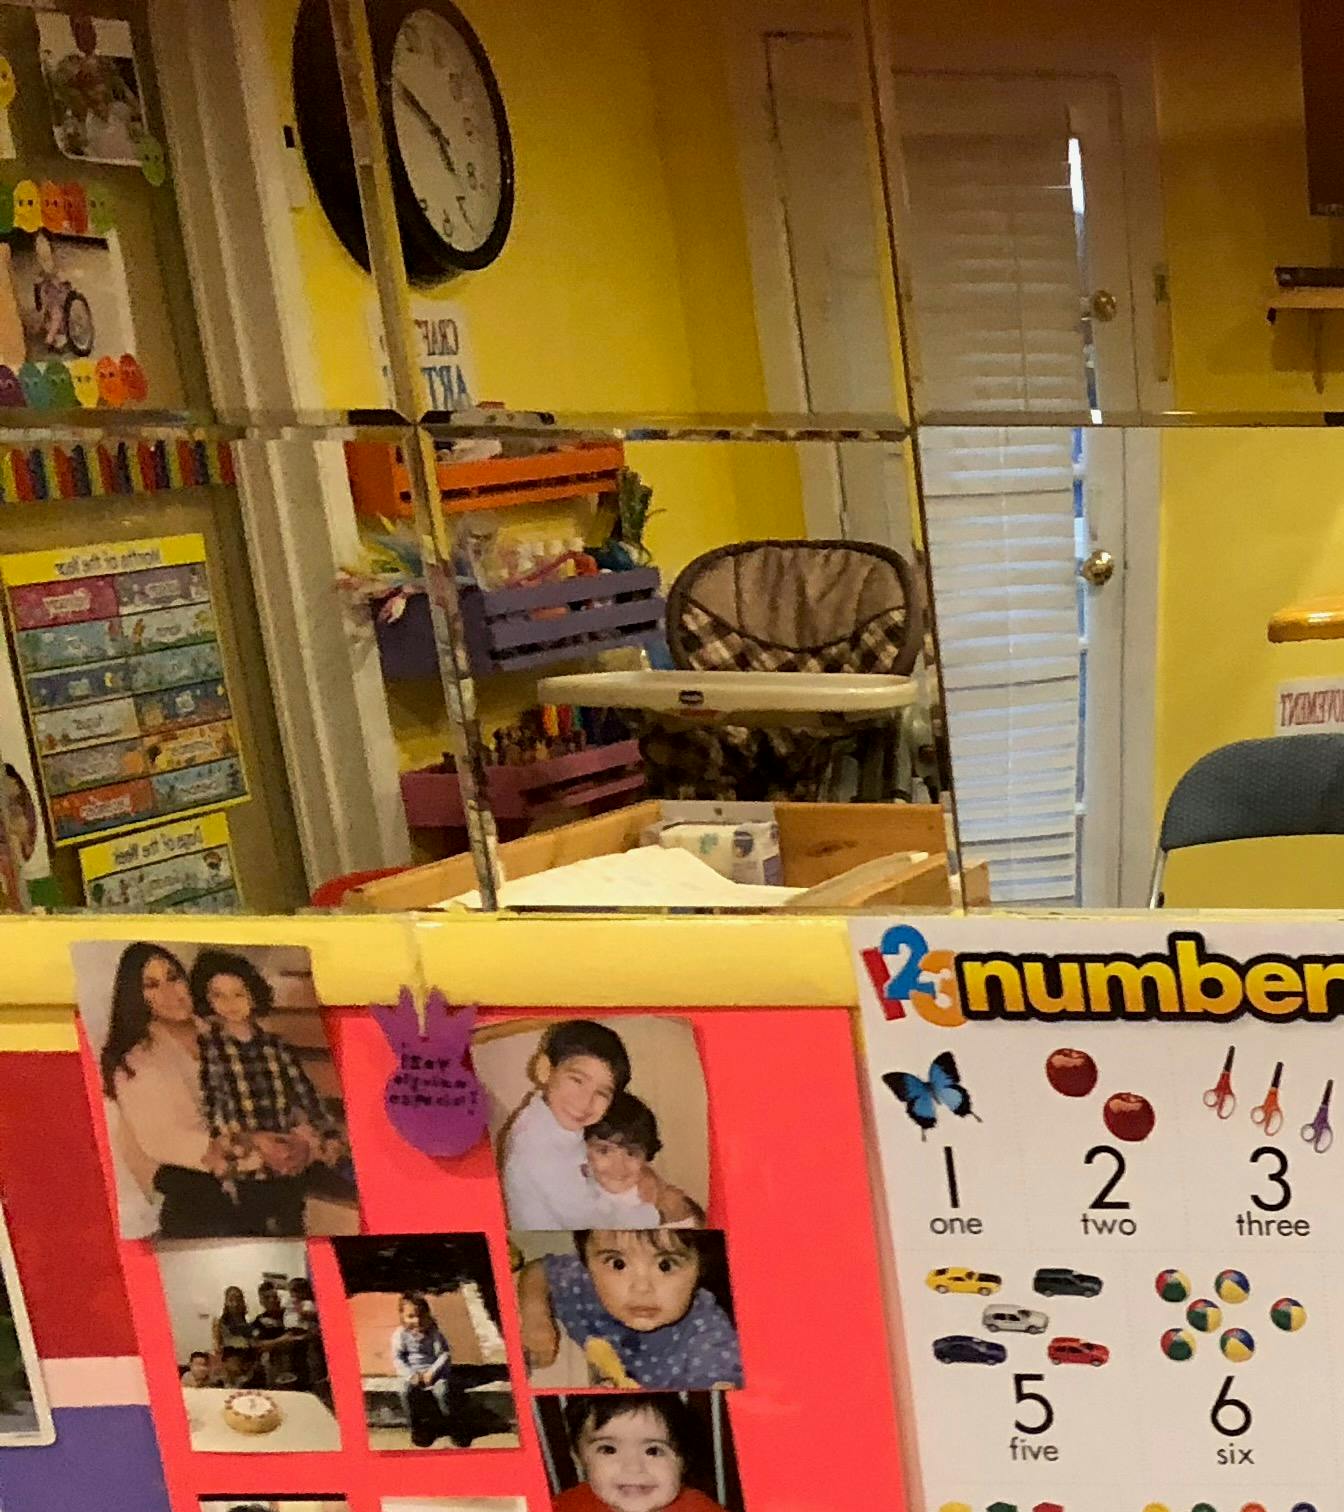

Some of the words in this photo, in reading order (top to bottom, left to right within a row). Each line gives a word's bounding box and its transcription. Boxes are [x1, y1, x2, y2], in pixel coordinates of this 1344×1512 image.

[943, 1146, 960, 1208] 1
[1084, 1146, 1129, 1210] 2
[1249, 1146, 1291, 1210] 3
[929, 1215, 982, 1236] one
[1081, 1213, 1137, 1236] two
[1236, 1213, 1310, 1237] three
[1015, 1373, 1055, 1434] 5
[1210, 1375, 1253, 1437] 6
[1009, 1438, 1060, 1462] five
[1217, 1441, 1255, 1465] six
